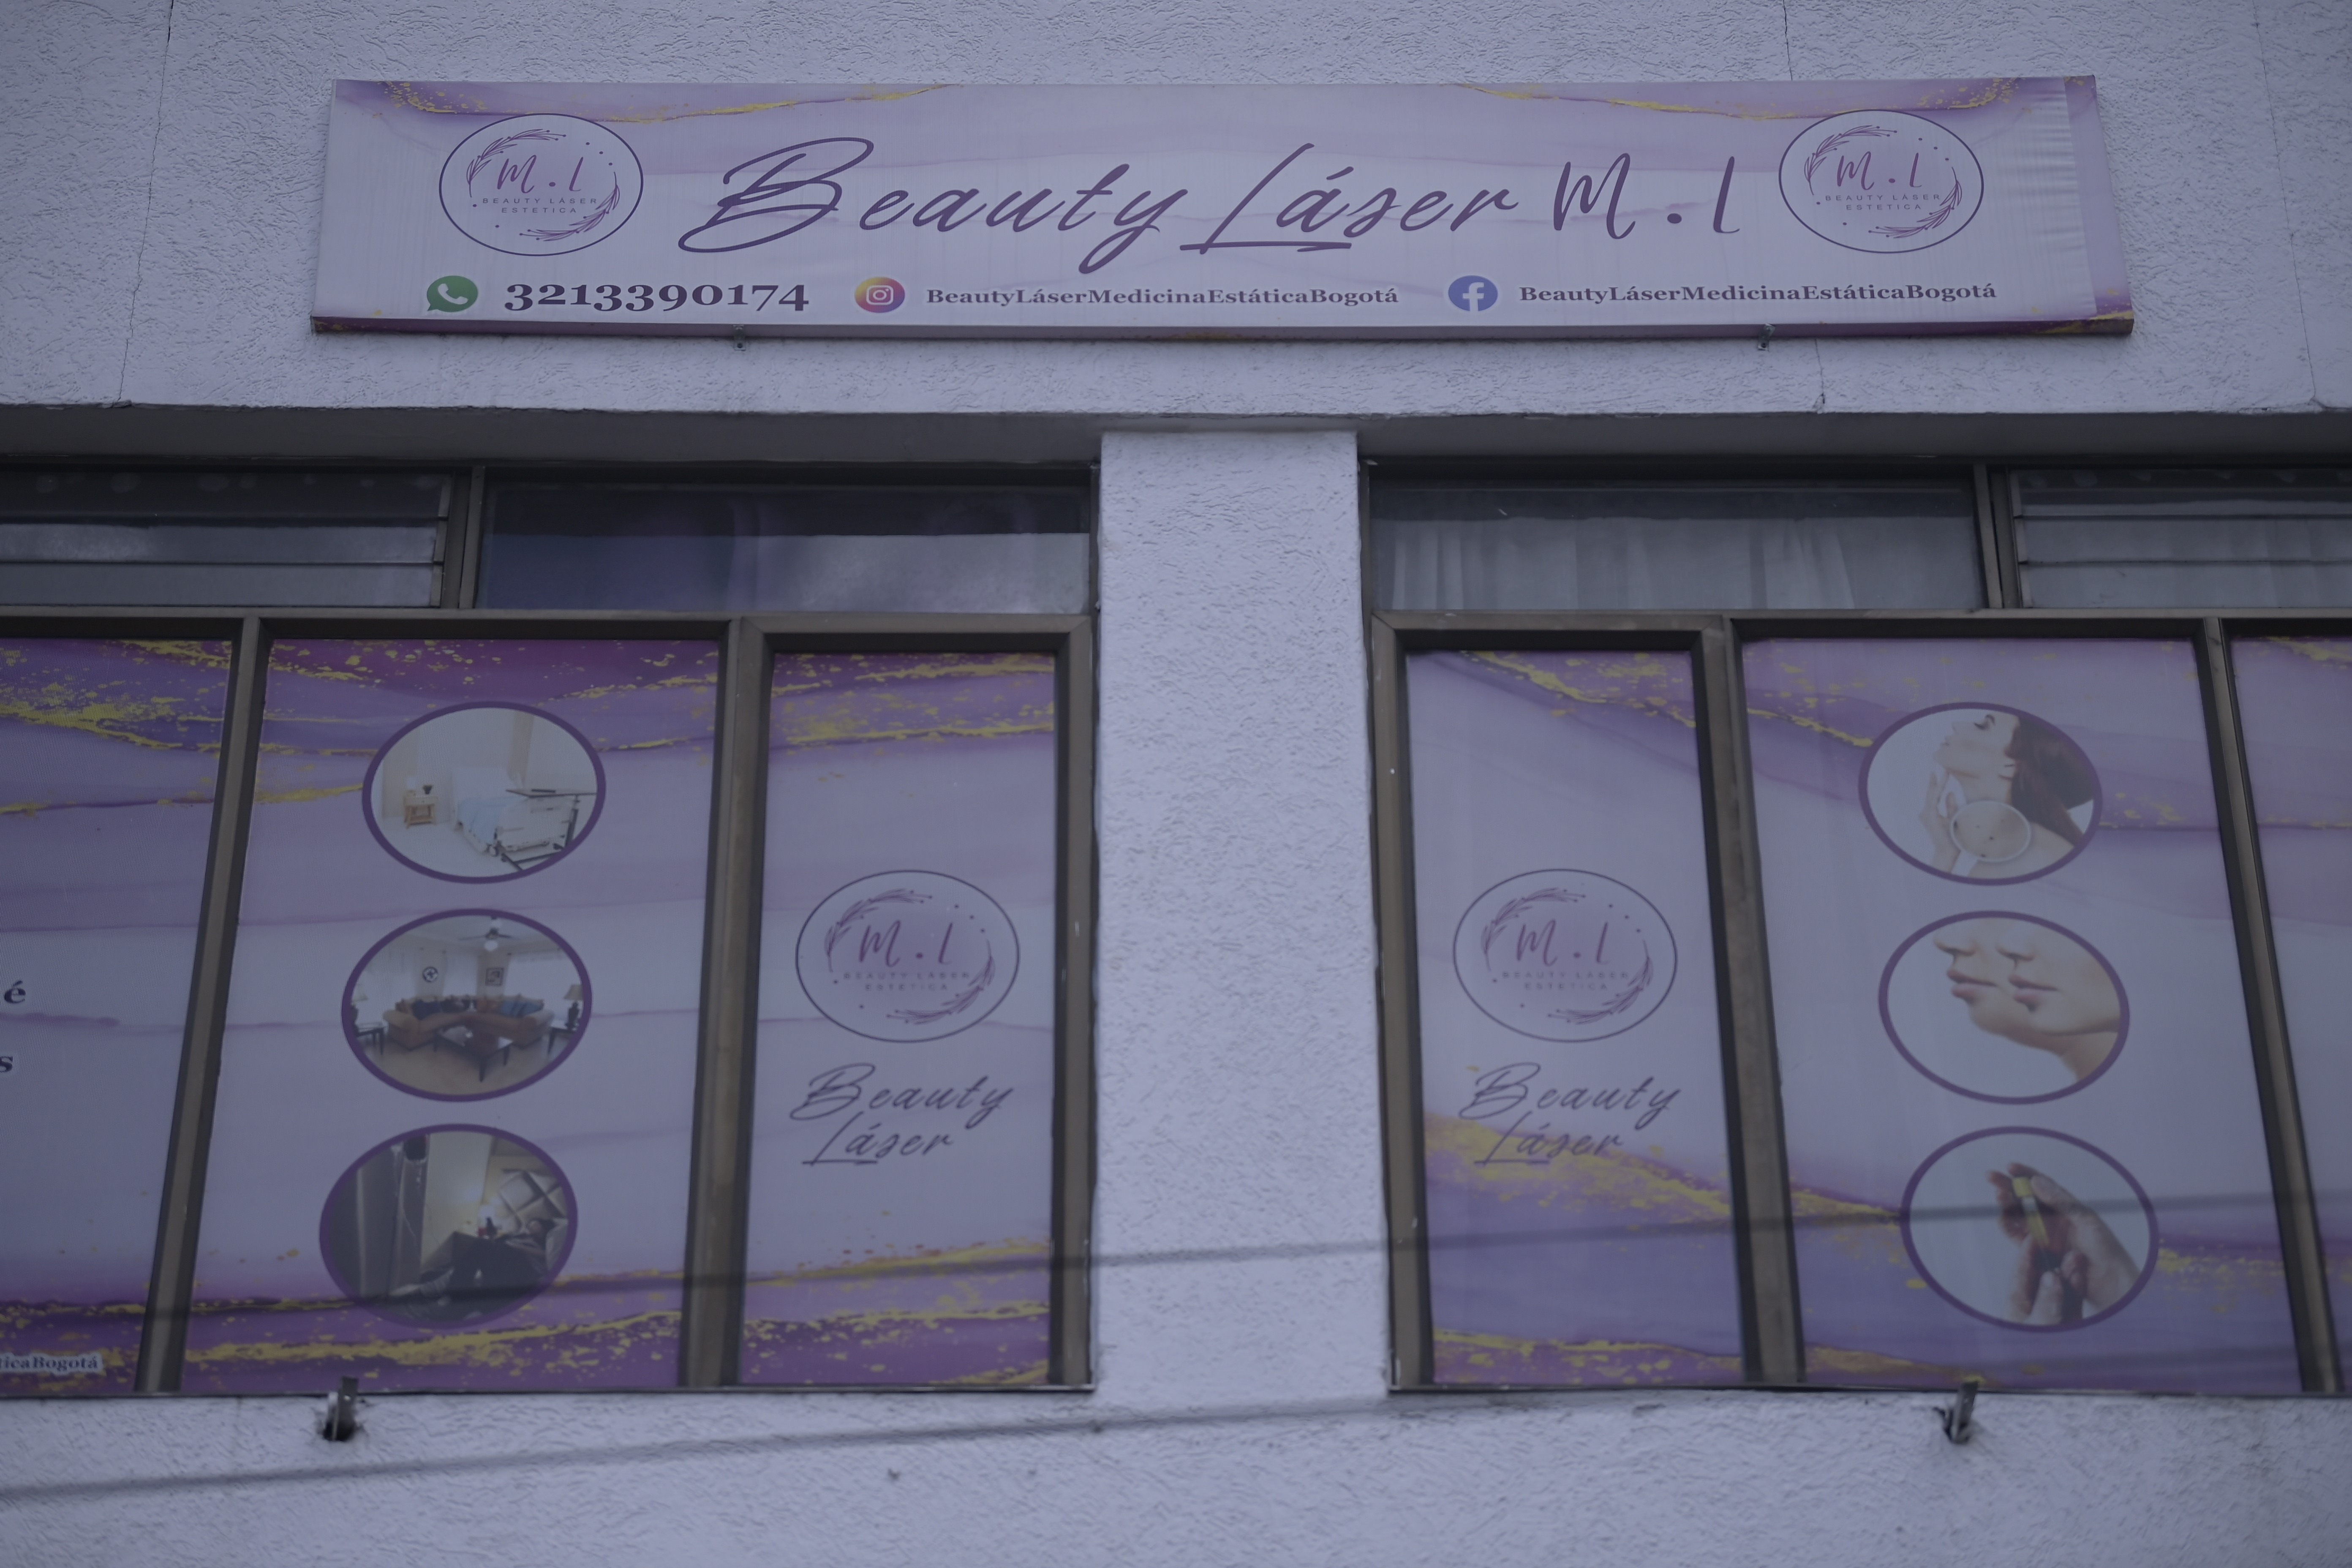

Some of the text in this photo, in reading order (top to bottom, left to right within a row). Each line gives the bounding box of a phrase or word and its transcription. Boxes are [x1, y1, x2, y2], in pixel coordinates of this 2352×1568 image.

[678, 137, 1188, 275] Beauty
[1179, 143, 1519, 255] Láser
[504, 283, 809, 311] 3213390174
[926, 287, 1399, 306] BeautyLáserMedicinaEstáticaBogotá
[1519, 283, 1997, 305] BeautyLáserMedicinaEstáticaBogotá
[789, 1062, 1015, 1130] Beauty
[1458, 1062, 1681, 1130] Beauty
[802, 1111, 954, 1166] Láser
[1474, 1111, 1624, 1165] Láser
[0, 1356, 98, 1372] icaBogotá
